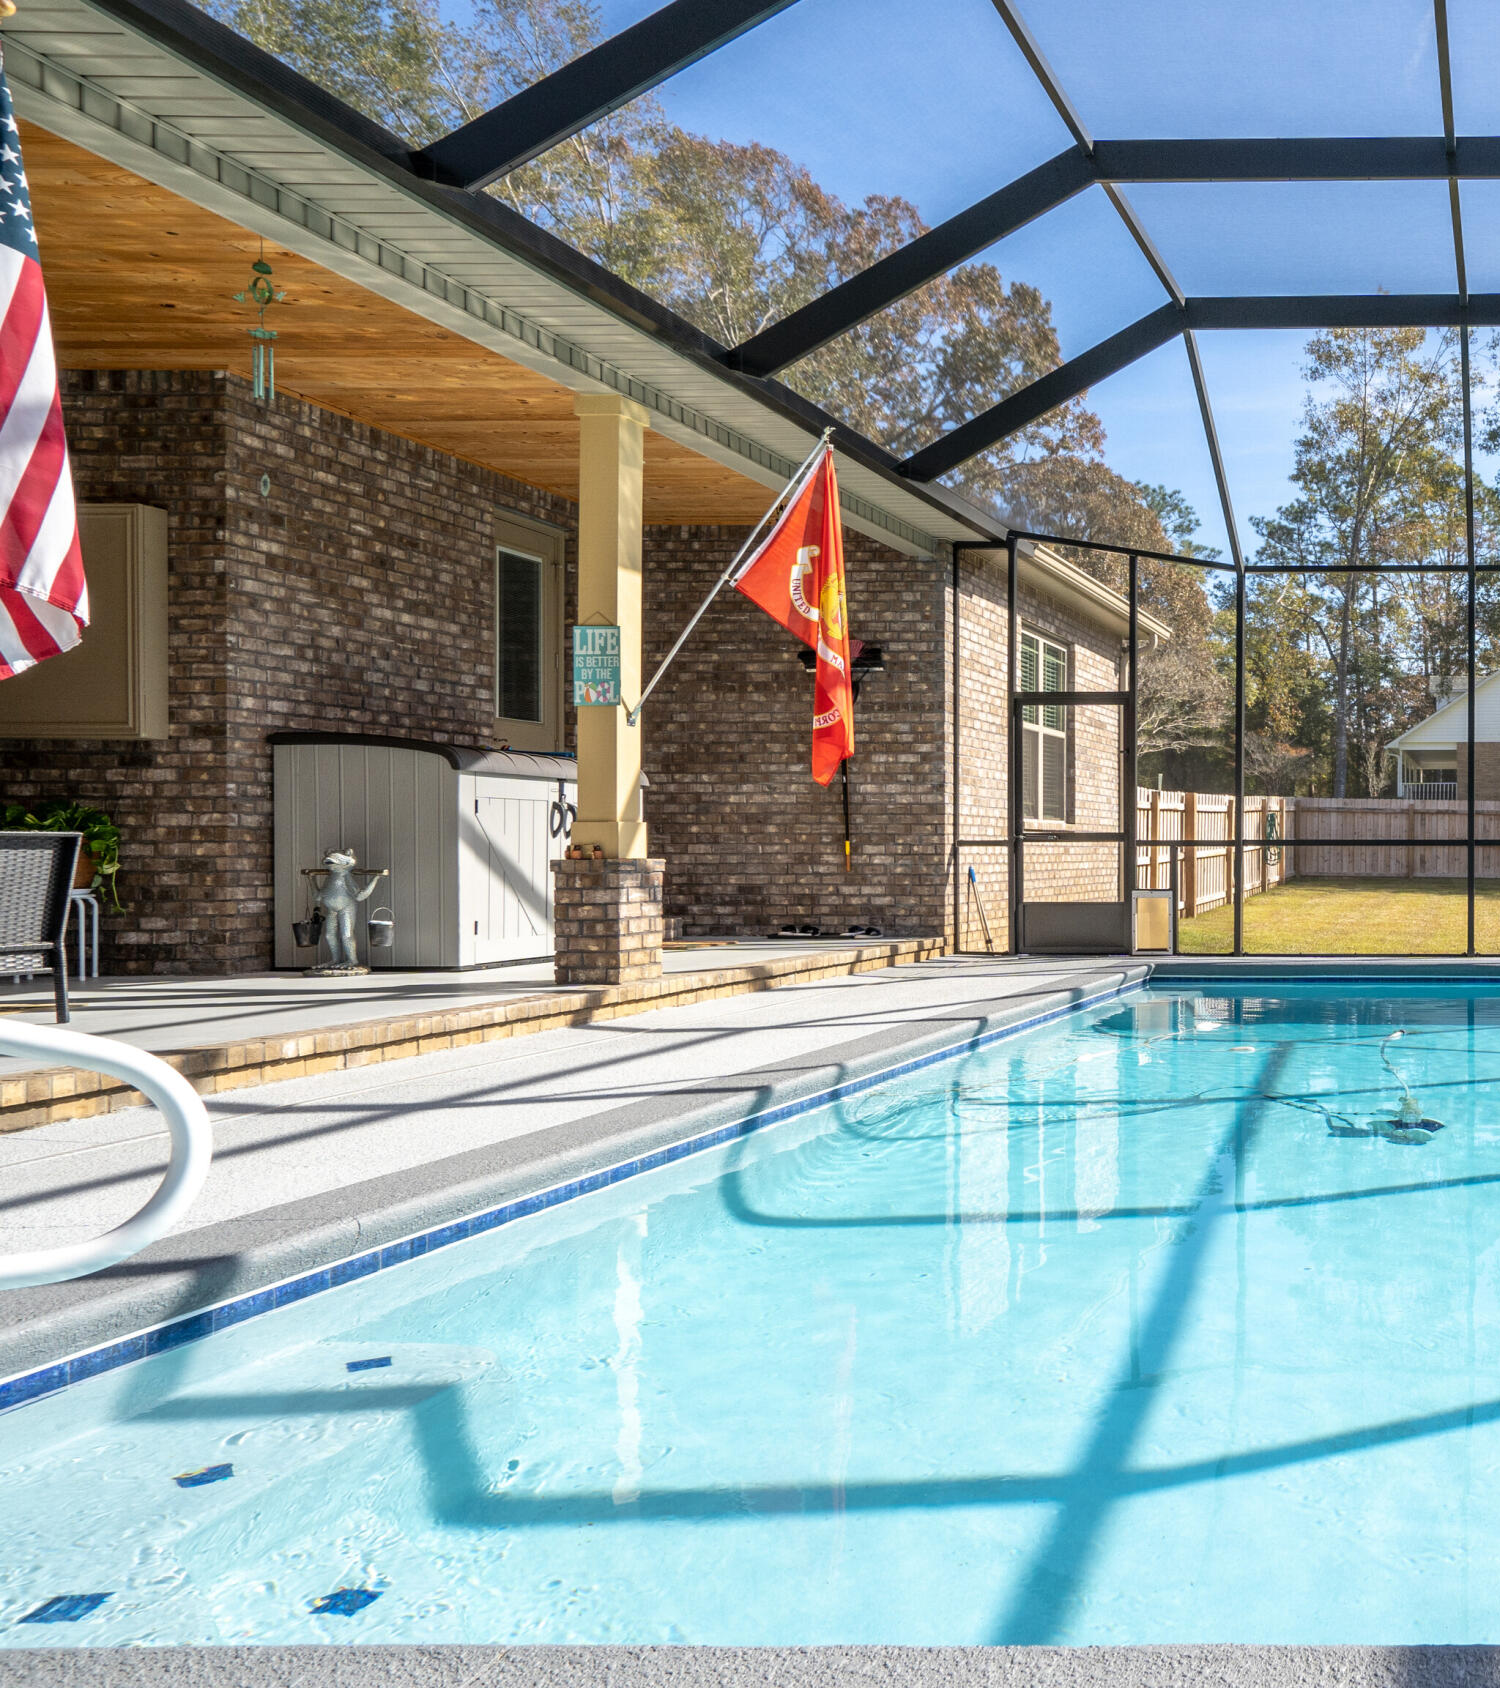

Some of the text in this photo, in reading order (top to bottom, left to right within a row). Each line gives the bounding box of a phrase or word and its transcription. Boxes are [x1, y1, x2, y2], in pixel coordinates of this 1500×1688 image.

[792, 578, 811, 614] UNITED
[575, 629, 618, 654] LIFE
[575, 656, 619, 667] IS BETTER
[581, 669, 612, 680] BY THE
